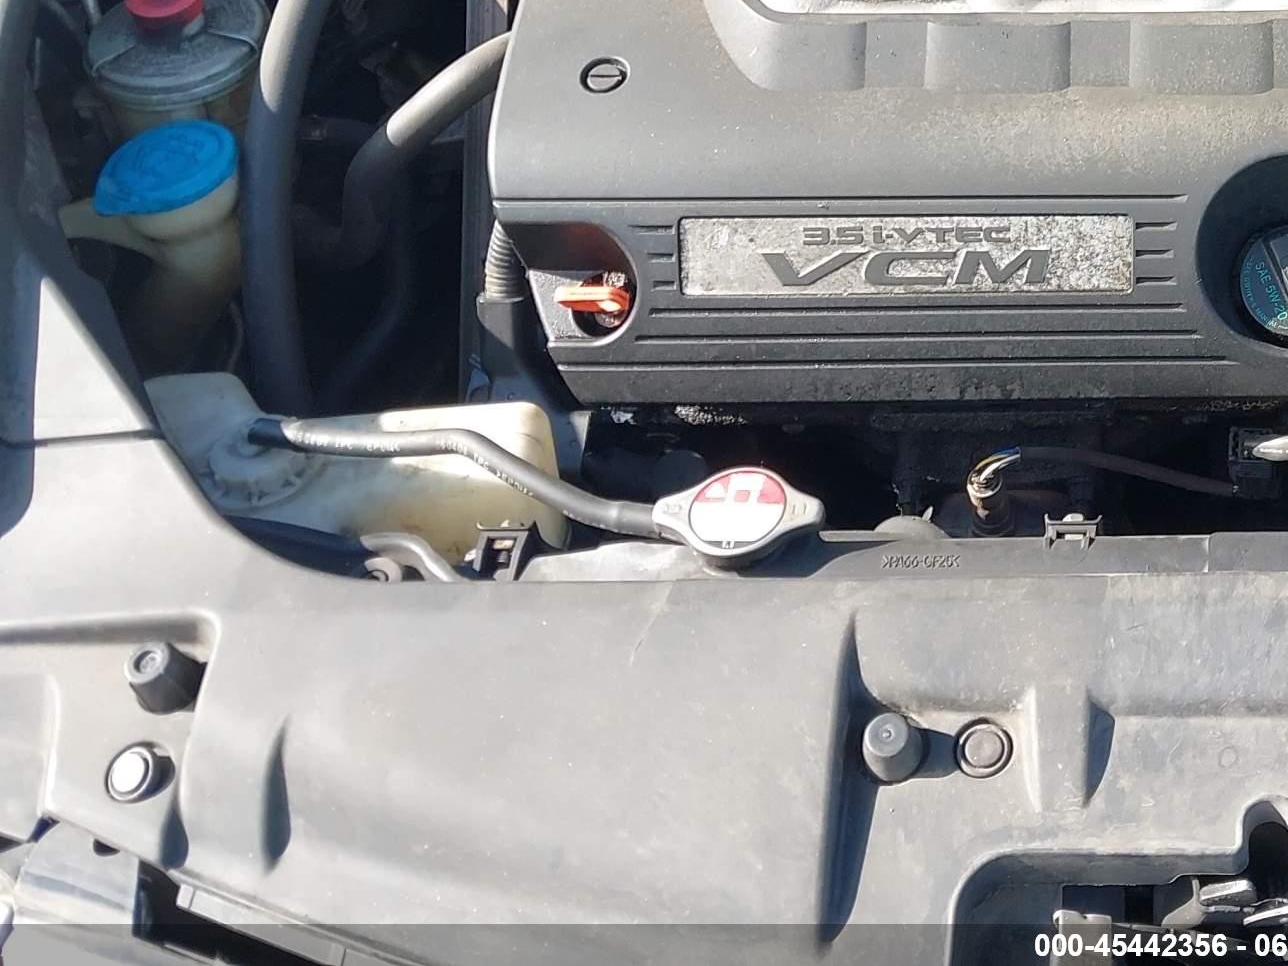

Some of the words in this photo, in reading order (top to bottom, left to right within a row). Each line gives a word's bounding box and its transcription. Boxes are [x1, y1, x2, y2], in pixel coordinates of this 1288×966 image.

[803, 226, 864, 245] 3.5
[761, 249, 1053, 286] VCM
[1255, 262, 1271, 284] SAE
[1265, 284, 1288, 321] 5W-20
